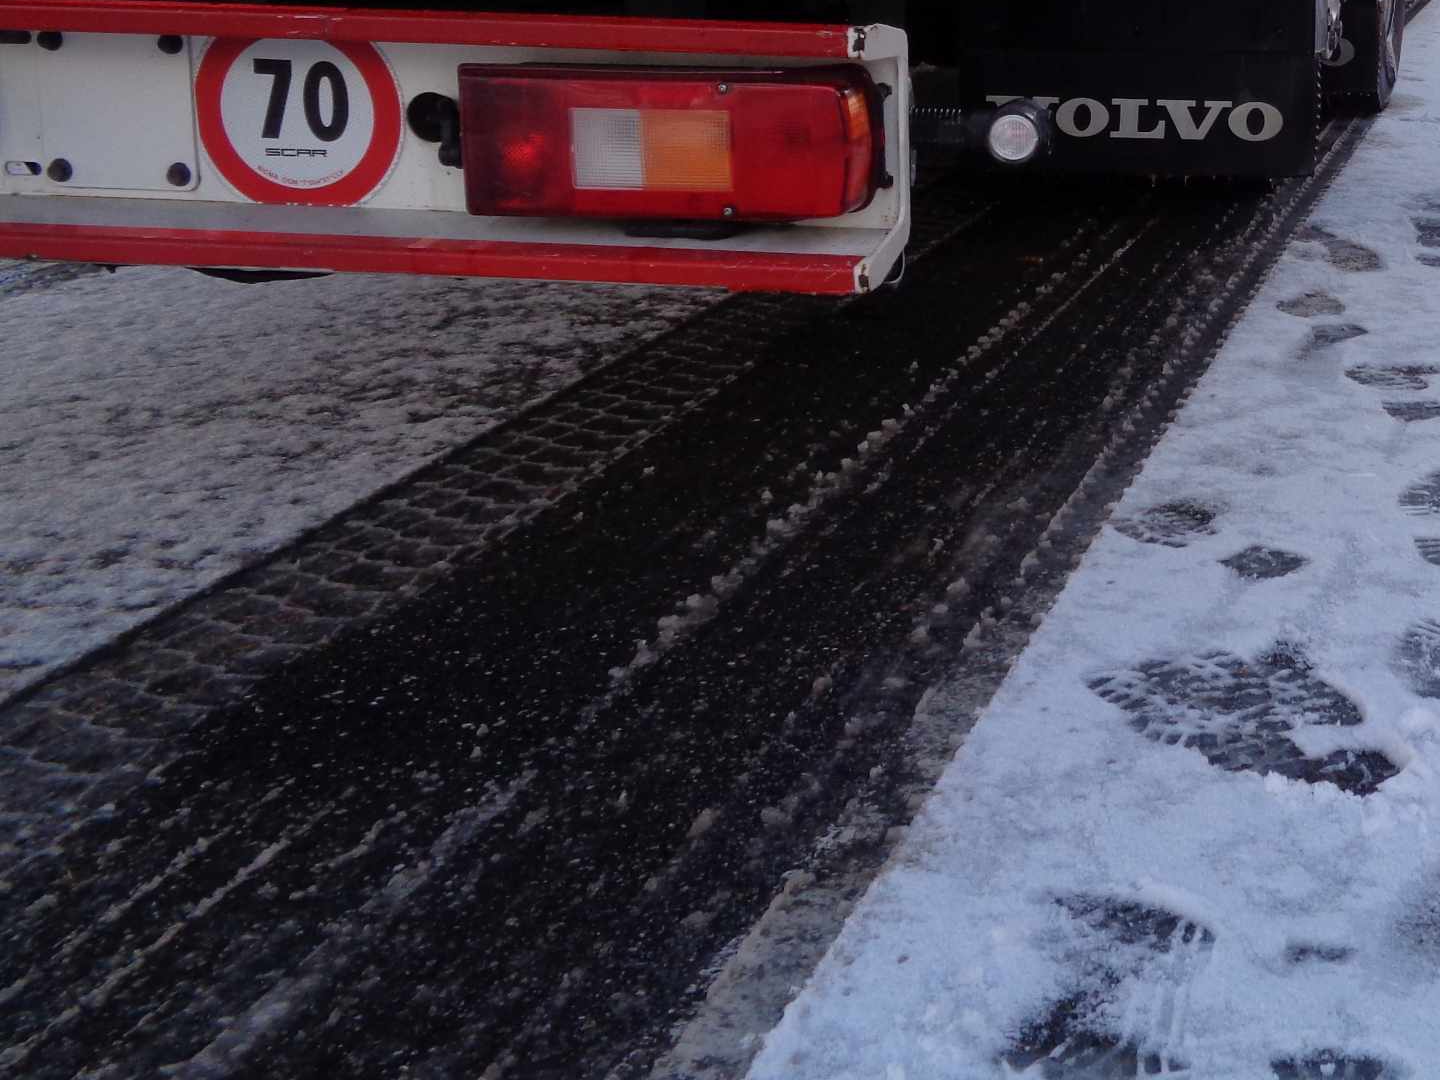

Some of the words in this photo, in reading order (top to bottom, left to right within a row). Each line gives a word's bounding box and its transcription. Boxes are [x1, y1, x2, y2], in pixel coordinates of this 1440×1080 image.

[252, 58, 349, 142] 70
[985, 95, 1284, 142] OLVO
[265, 148, 327, 157] SCAR
